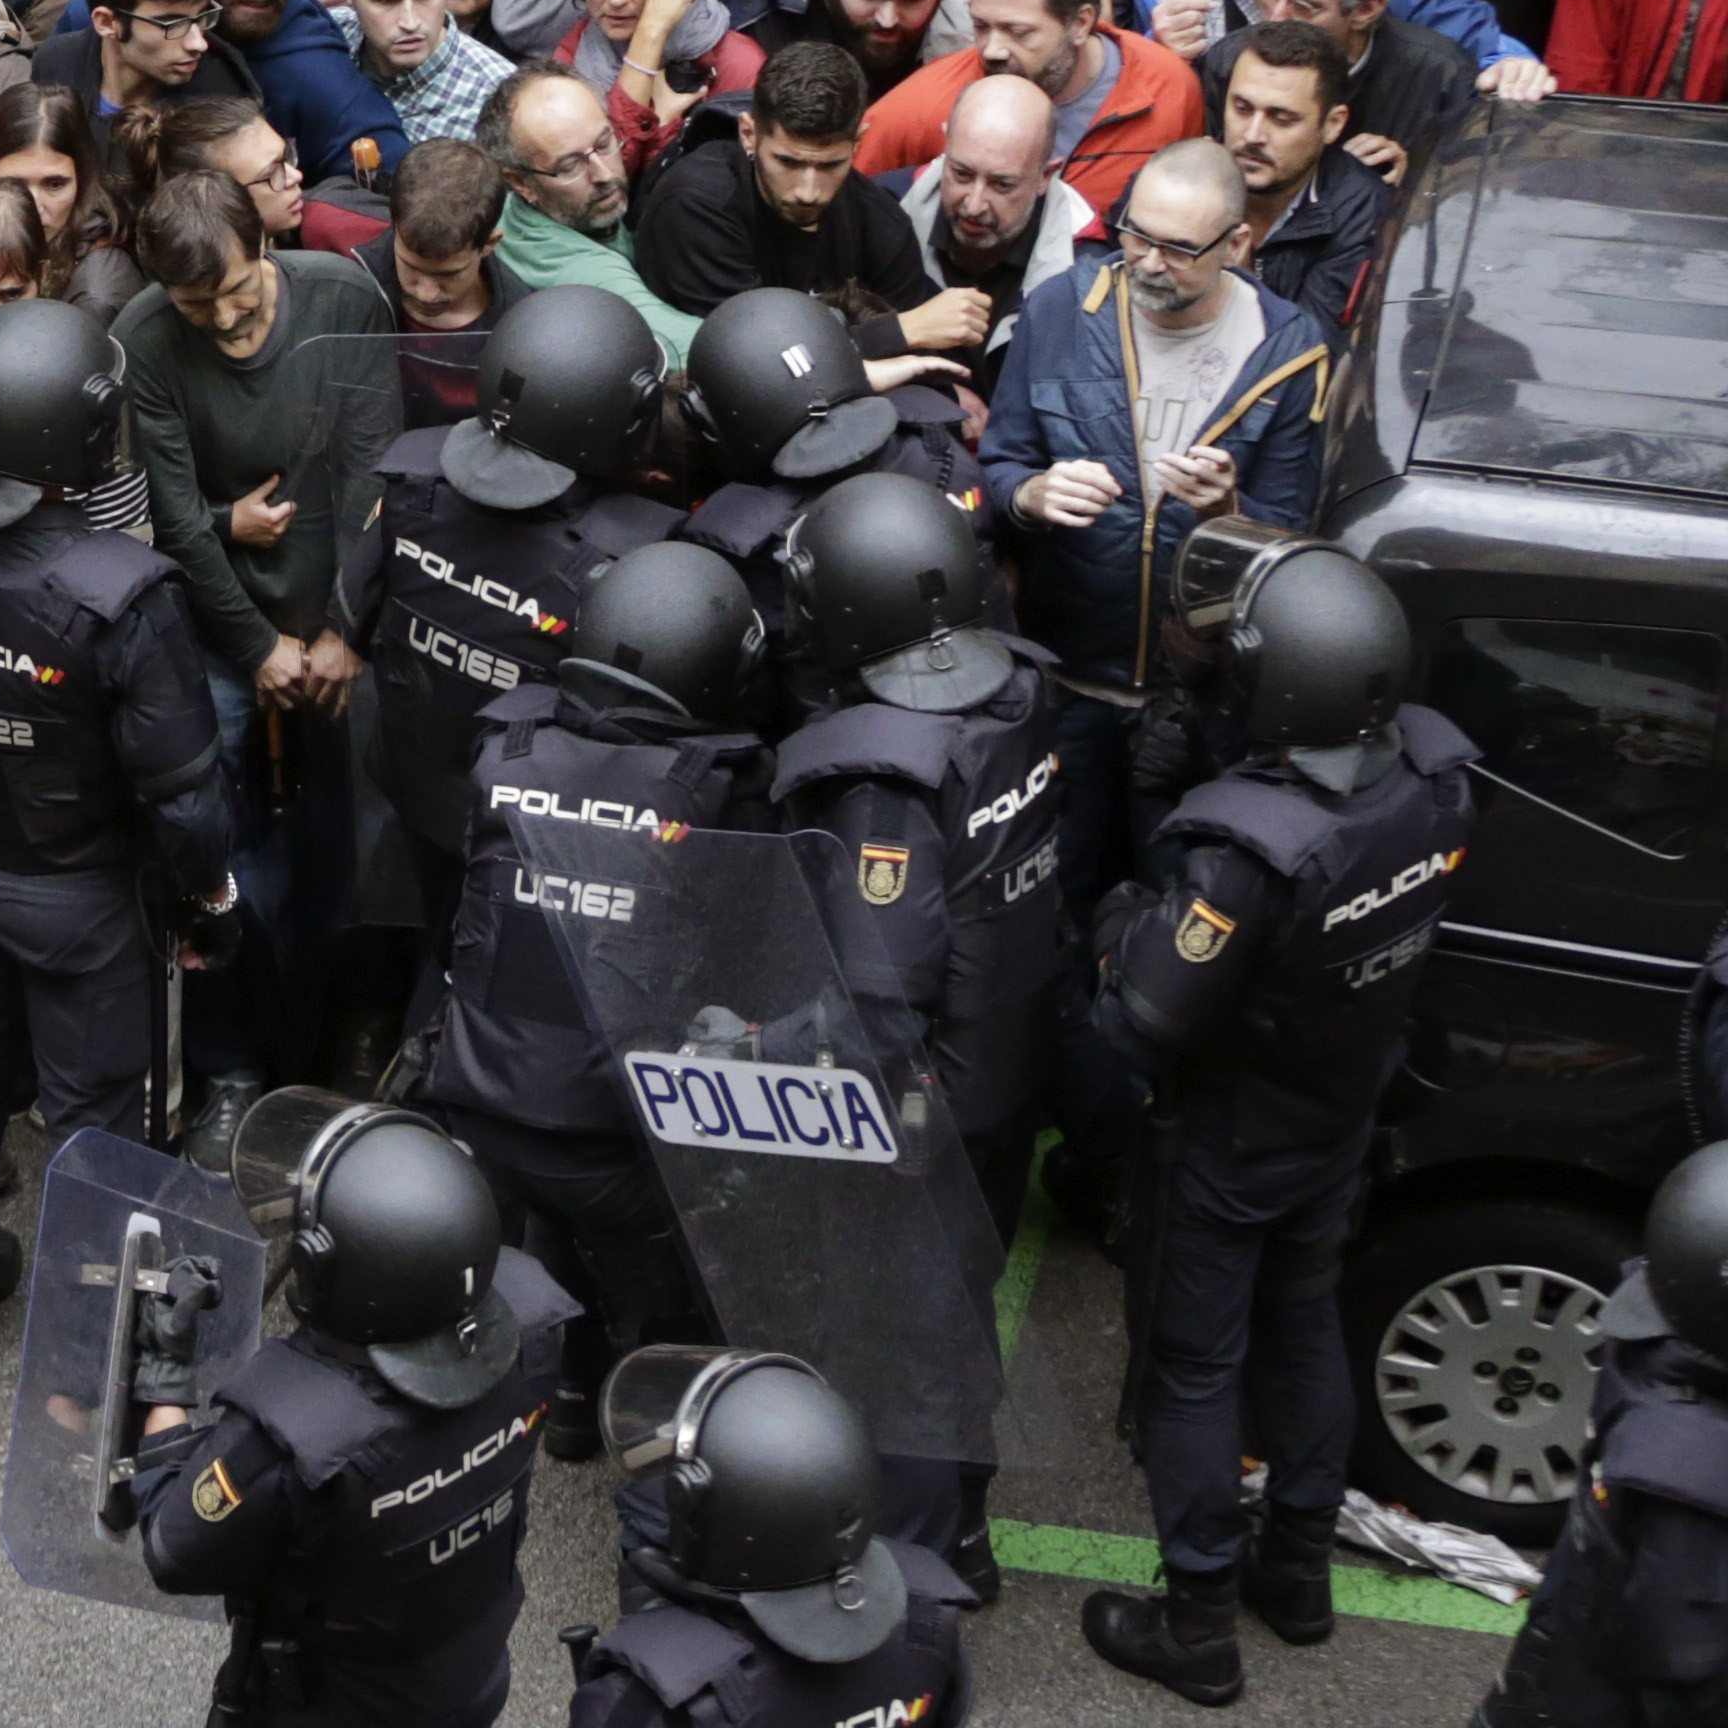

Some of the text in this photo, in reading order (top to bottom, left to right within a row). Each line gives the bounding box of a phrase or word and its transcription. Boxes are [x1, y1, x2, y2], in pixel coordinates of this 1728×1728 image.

[395, 537, 540, 619] POLICIA
[409, 617, 521, 690] UC163
[490, 785, 661, 837] POLICIA
[514, 868, 636, 922] UC162
[1322, 852, 1448, 932] POLICIA
[632, 1062, 893, 1153] POLICIA
[371, 1416, 529, 1520] POLICIA
